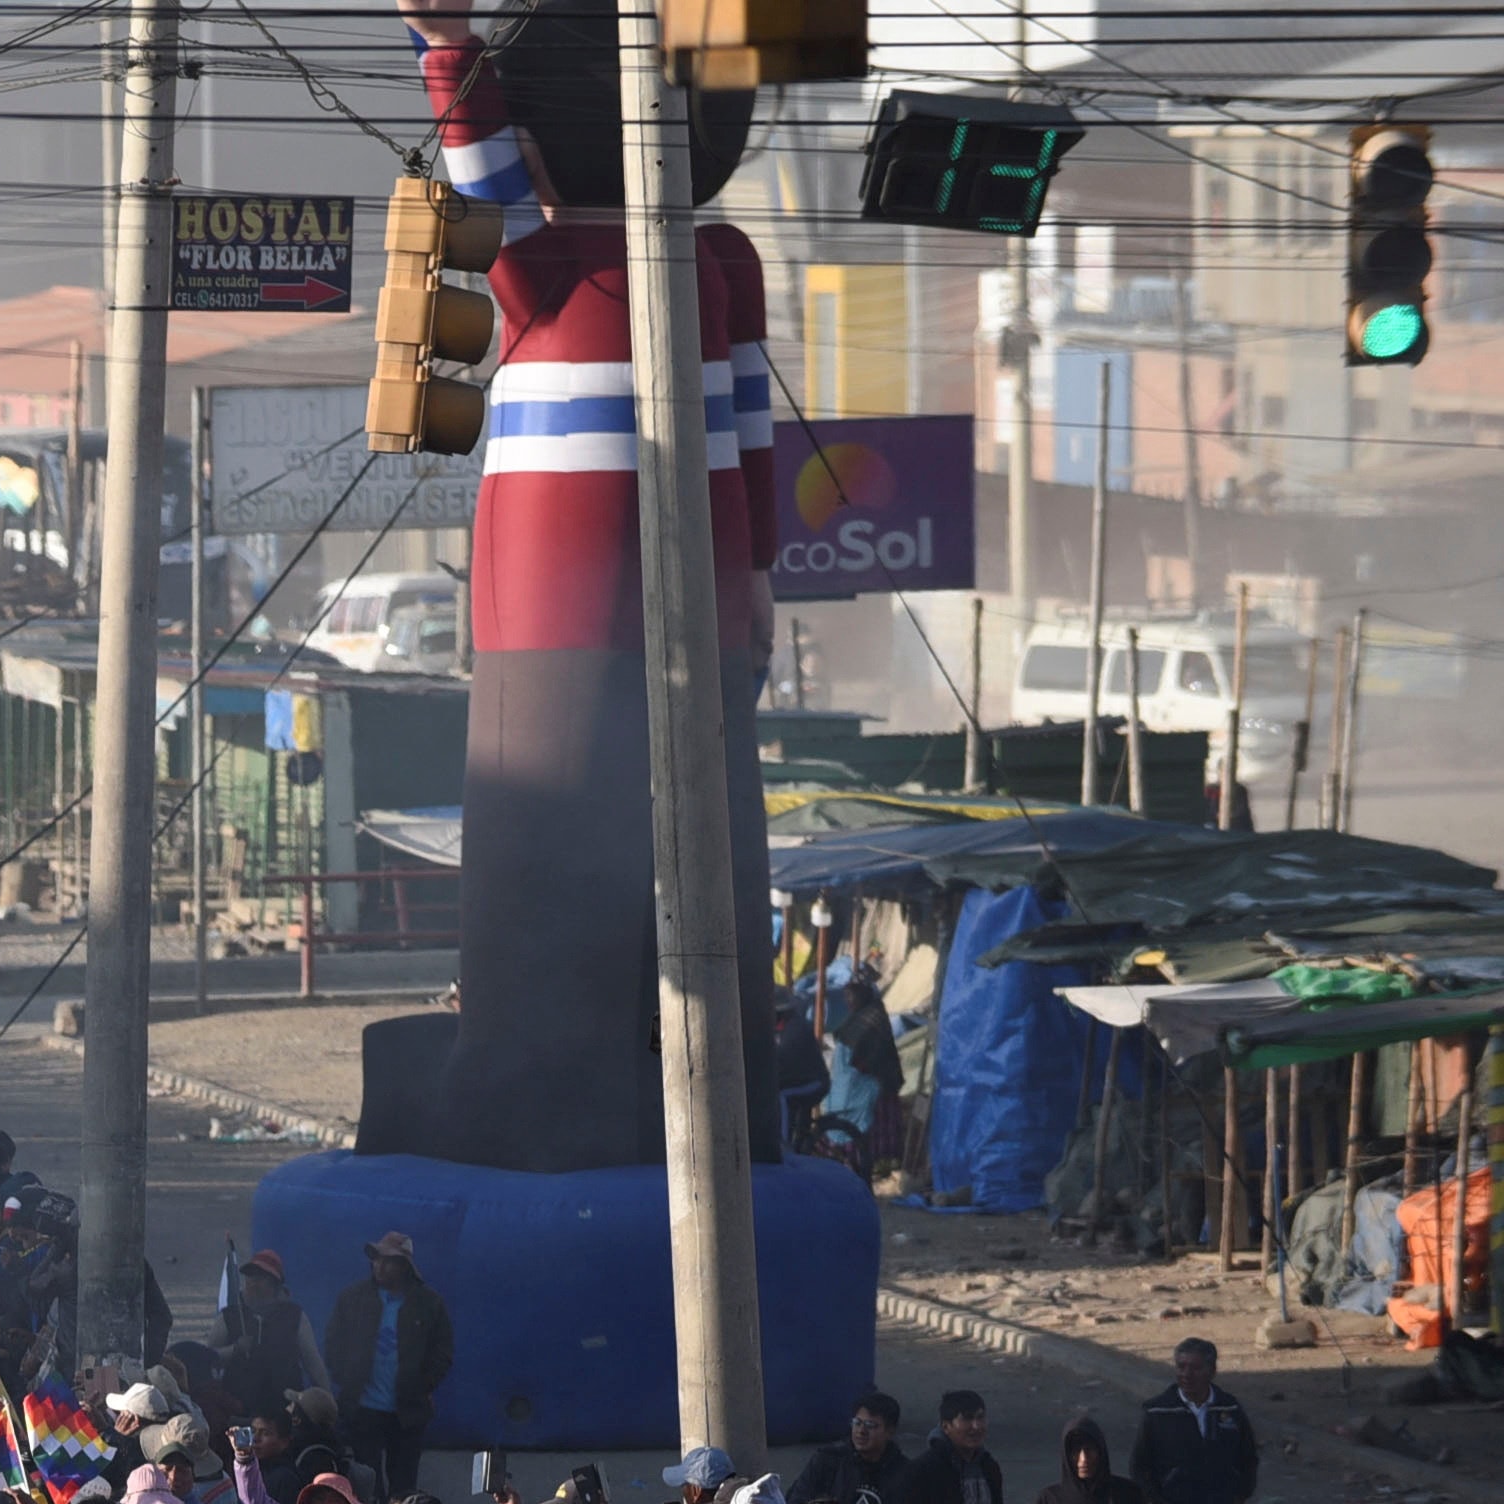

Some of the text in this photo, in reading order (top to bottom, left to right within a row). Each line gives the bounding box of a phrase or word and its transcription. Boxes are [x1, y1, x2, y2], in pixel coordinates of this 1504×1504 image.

[176, 199, 350, 244] HOSTAL
[175, 274, 259, 288] A una cuadra
[772, 517, 933, 573] coSol
